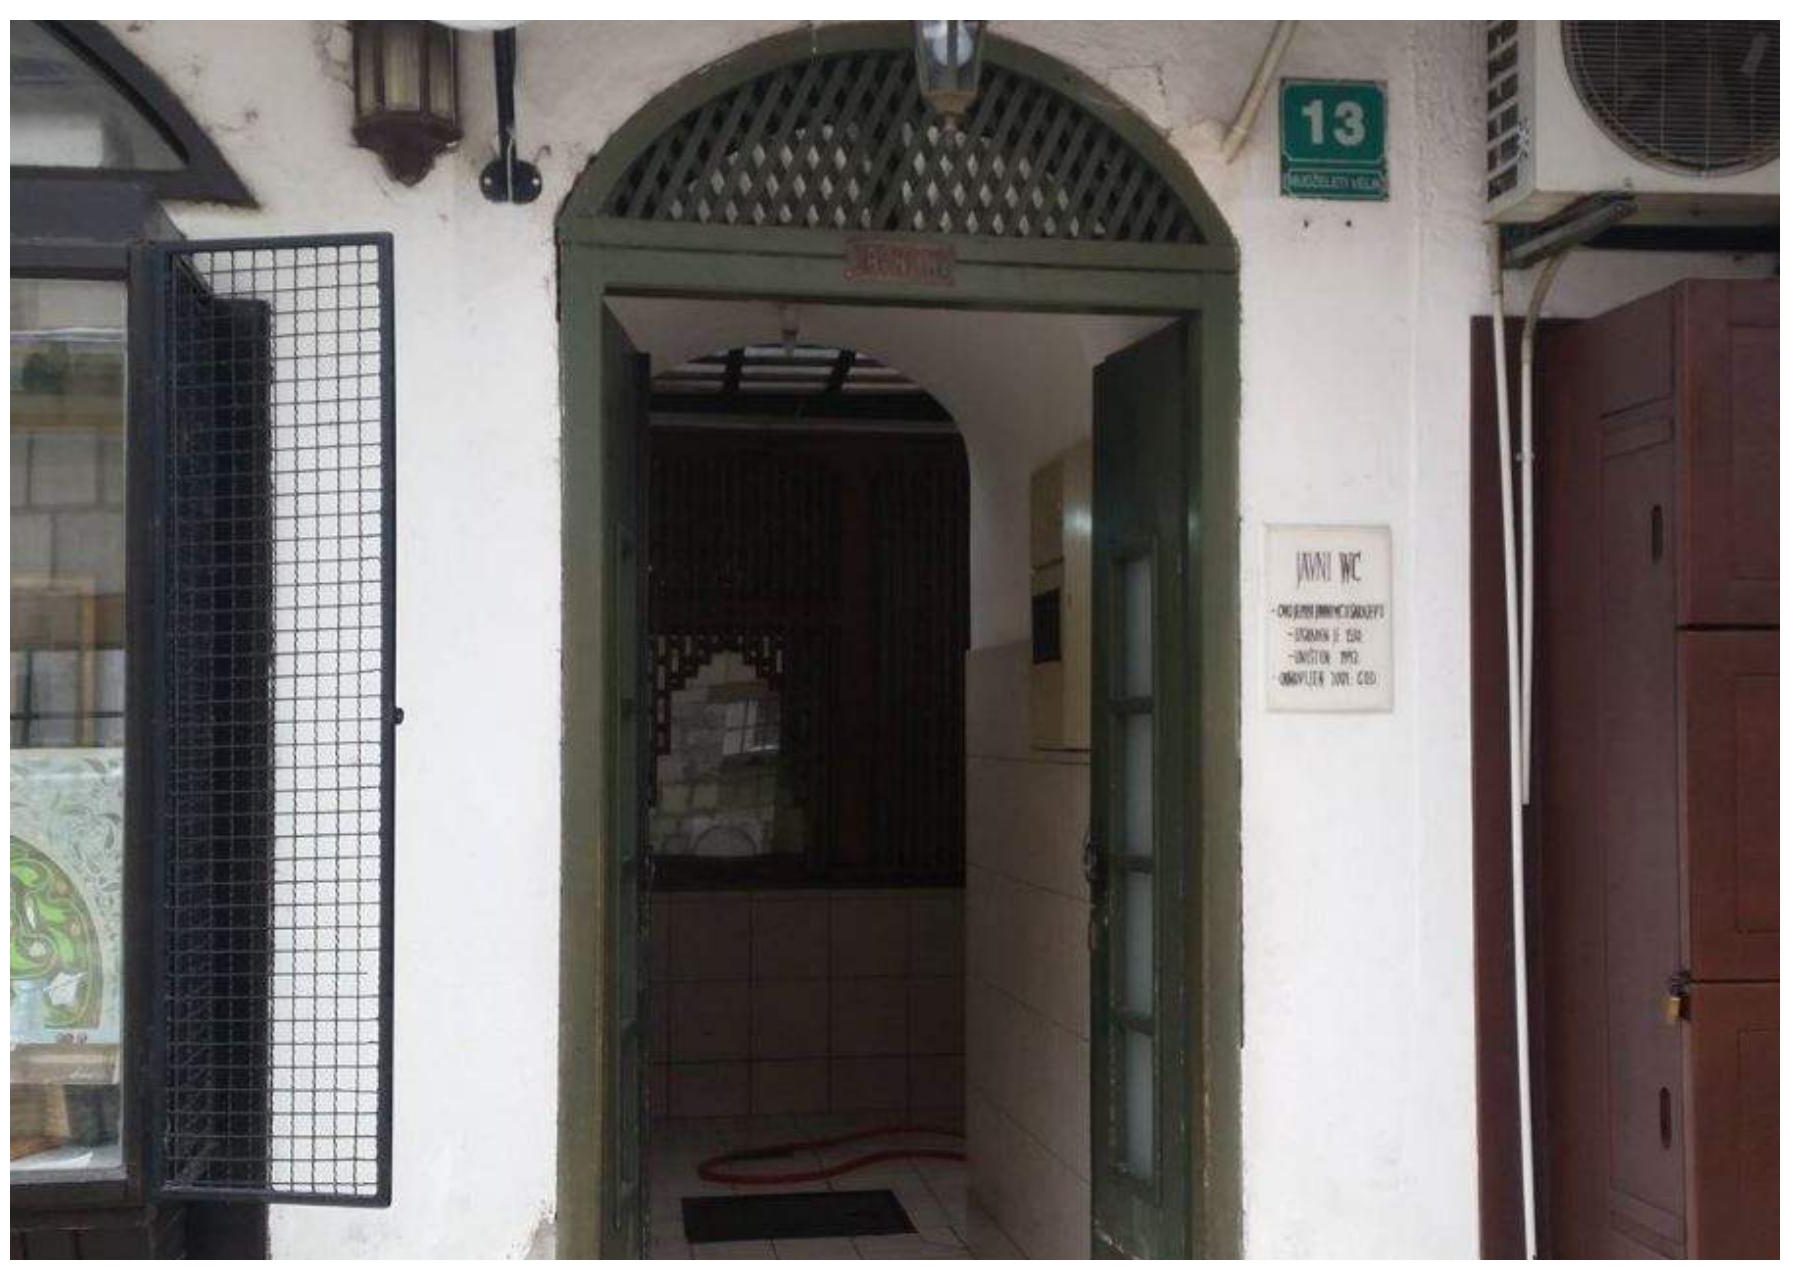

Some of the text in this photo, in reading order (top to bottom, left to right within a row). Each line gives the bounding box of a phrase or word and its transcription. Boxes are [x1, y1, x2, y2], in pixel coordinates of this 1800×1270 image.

[1302, 99, 1366, 147] 13
[1296, 550, 1363, 588] JAVNI WC
